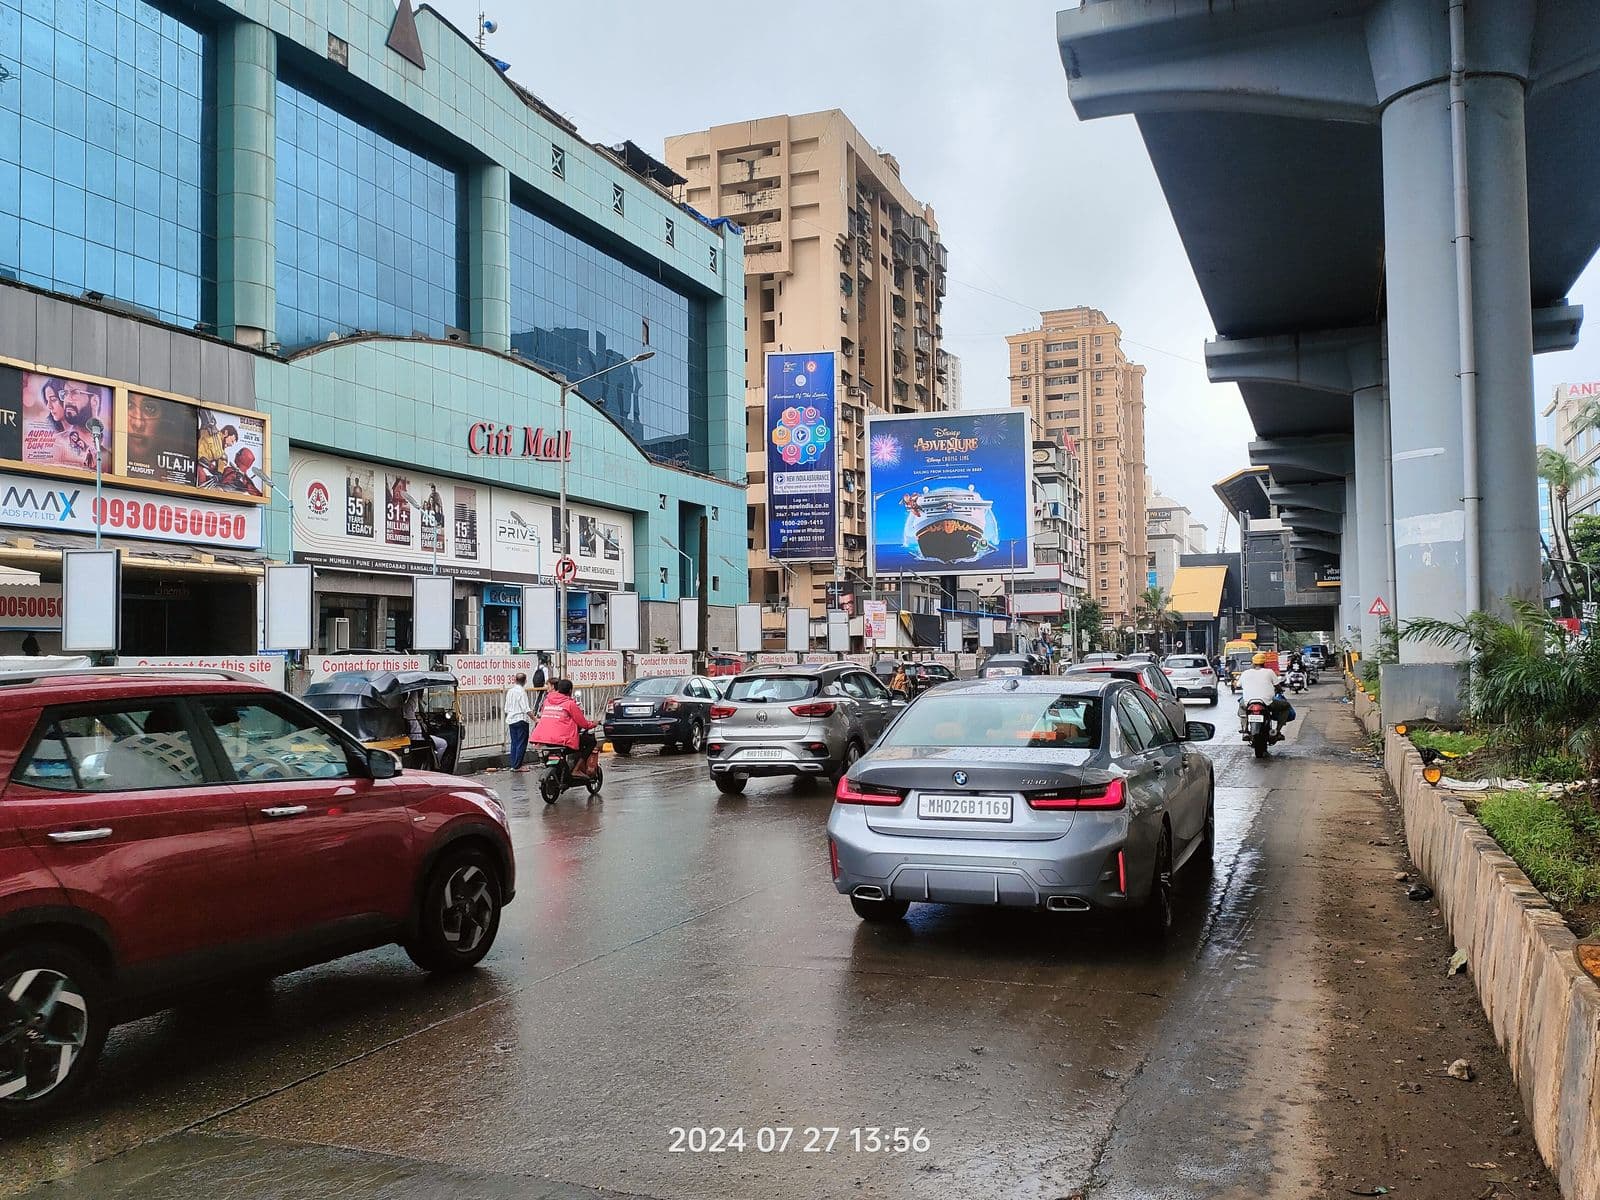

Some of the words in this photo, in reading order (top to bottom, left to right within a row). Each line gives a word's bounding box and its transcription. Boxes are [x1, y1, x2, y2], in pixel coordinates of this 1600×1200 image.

[932, 427, 961, 438] Disney
[468, 422, 513, 456] Citi
[520, 427, 571, 459] Mall
[914, 437, 979, 453] ADVENTURE
[157, 454, 195, 474] ULAJH
[131, 466, 155, 475] AUGUST
[2, 486, 80, 521] MAX
[347, 496, 364, 516] 55
[2, 509, 21, 517] ADS
[92, 496, 246, 540] 9930050050
[387, 503, 408, 522] 31+
[347, 523, 373, 535] LEGACY
[386, 521, 409, 532] MILLION
[456, 520, 468, 538] 15
[329, 557, 351, 565] MUMBAI
[375, 561, 406, 569] AHMEDABAD
[591, 566, 615, 575] RESIDENCES
[249, 660, 271, 671] site
[322, 660, 364, 672] Contact
[366, 660, 380, 671] for
[383, 660, 400, 670] this
[402, 659, 419, 670] site
[456, 658, 488, 669] Contact
[489, 659, 501, 669] for
[502, 659, 516, 669] this
[517, 659, 531, 668] site
[567, 658, 583, 667] ntact
[584, 658, 594, 667] for
[595, 658, 606, 666] this
[606, 658, 617, 666] site
[461, 675, 476, 685] Cell
[482, 675, 506, 685] 96199
[580, 672, 597, 680] 96199
[598, 672, 616, 680] 39118
[928, 799, 1009, 815] MH02GB1169
